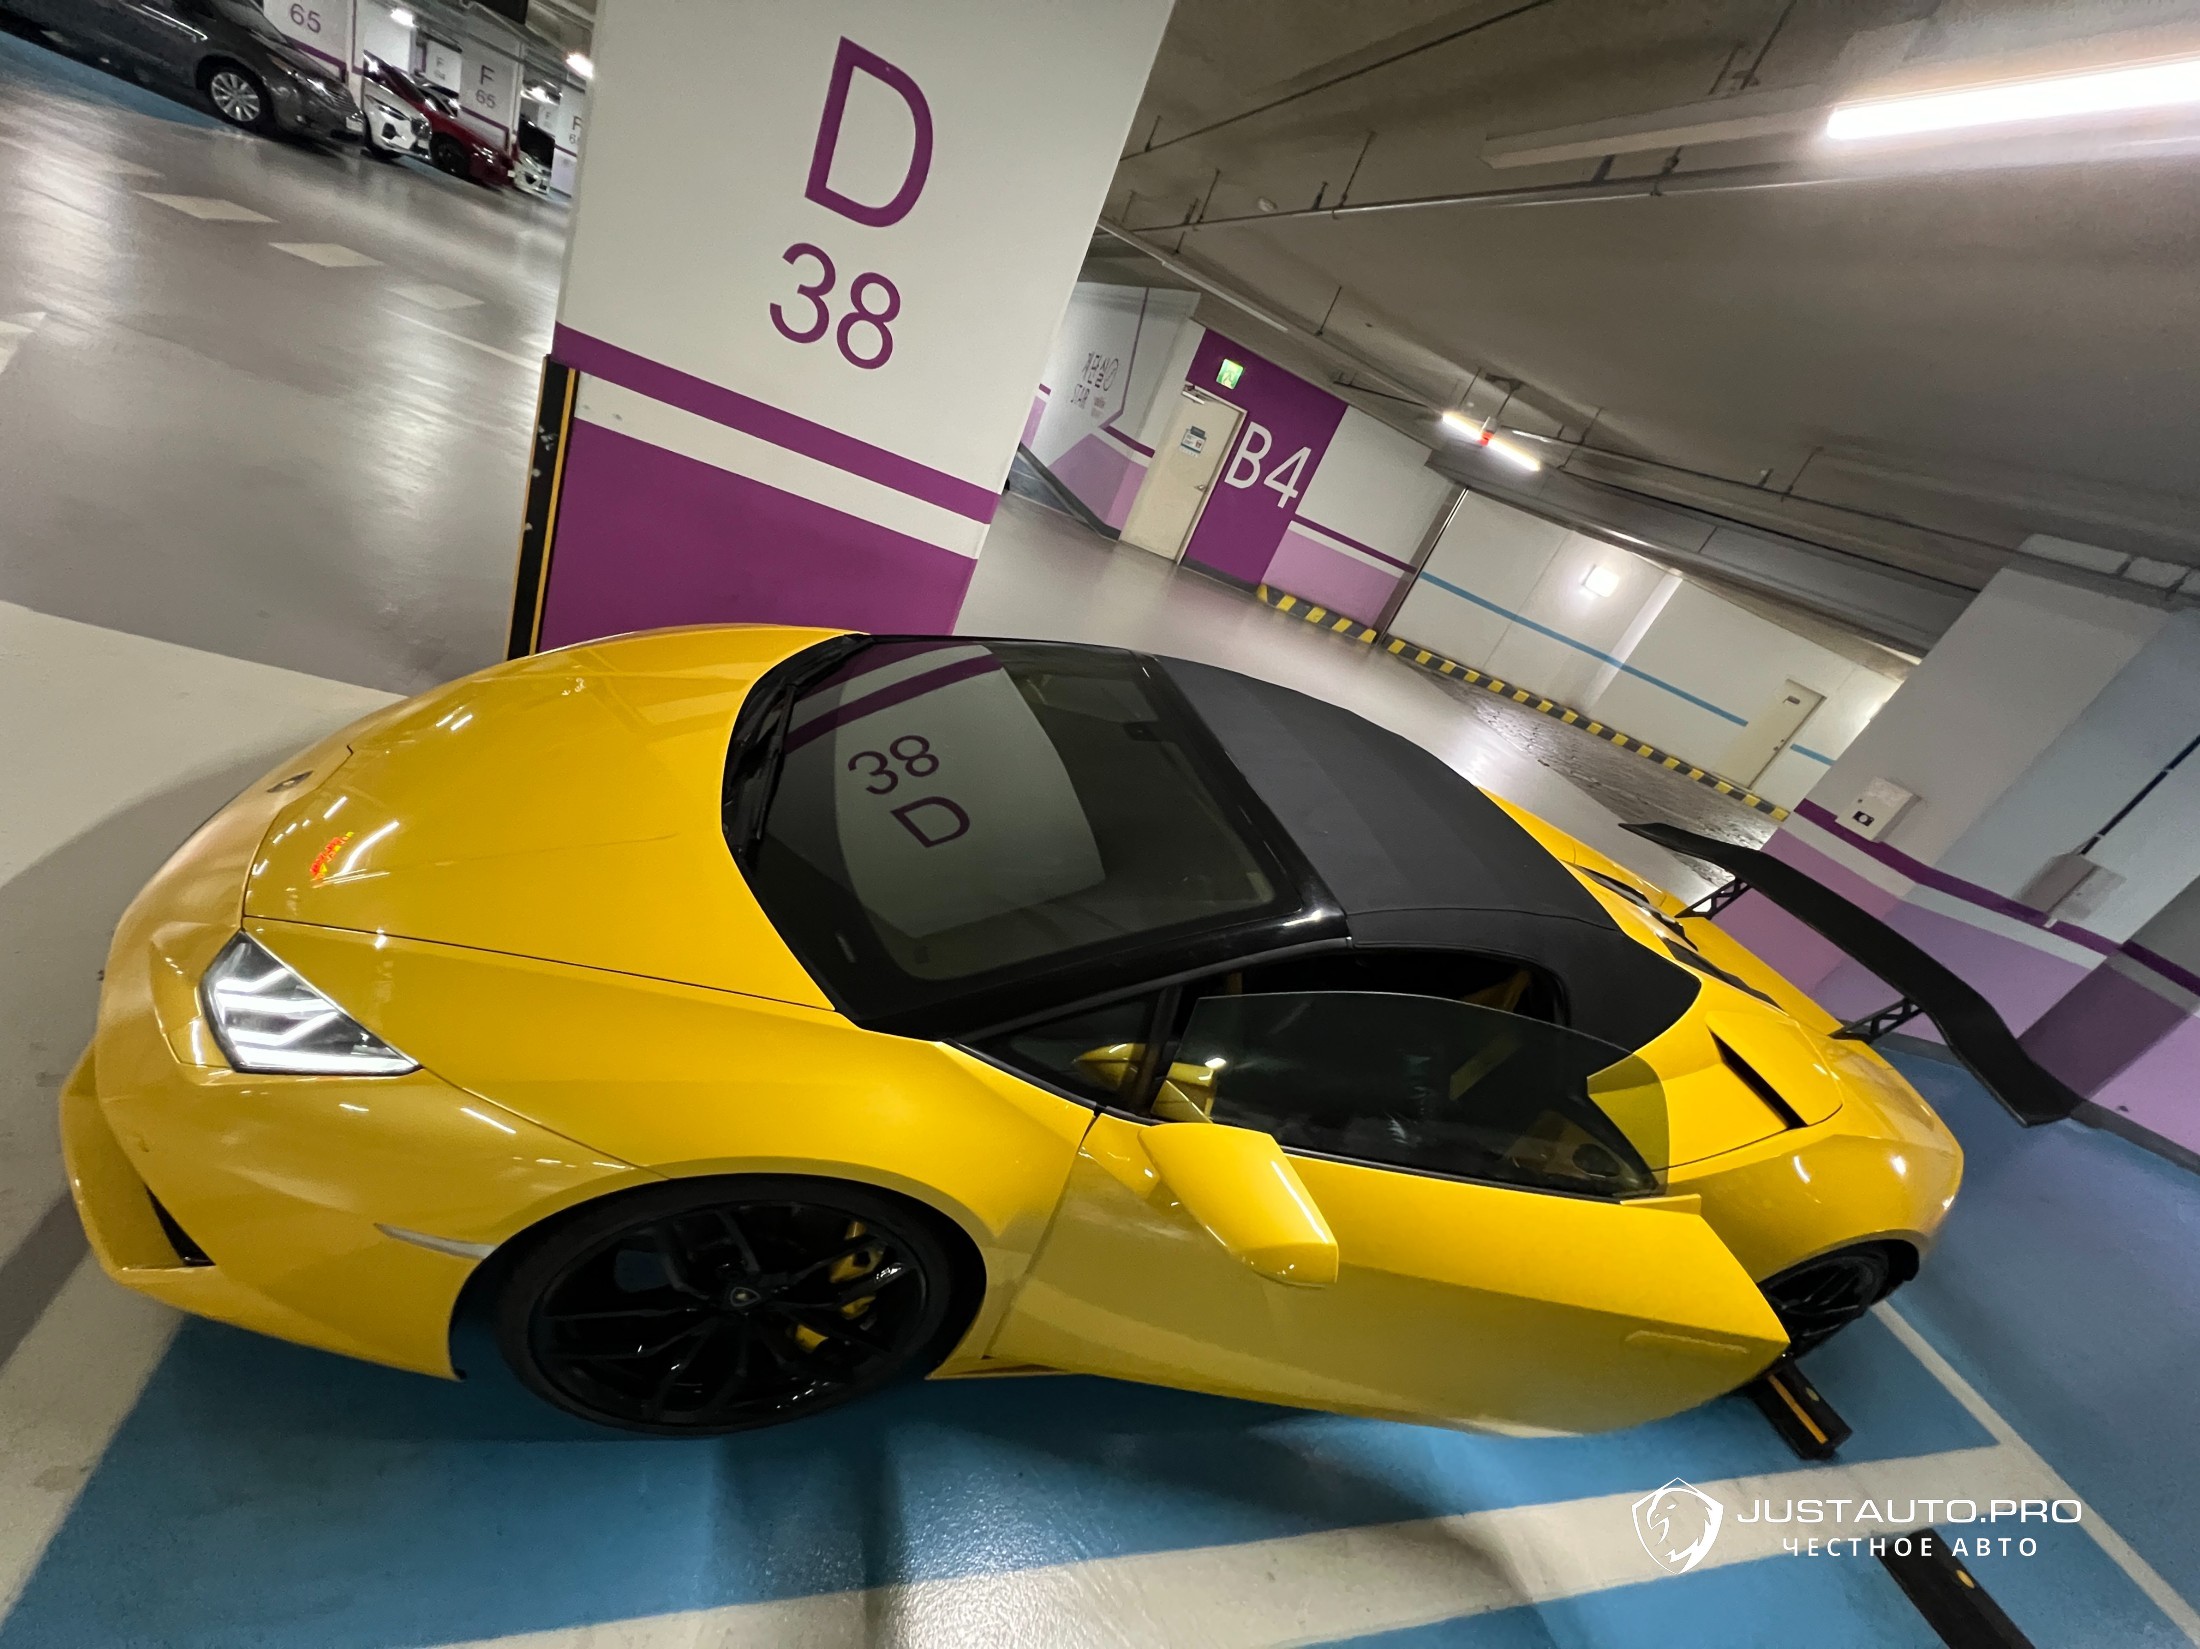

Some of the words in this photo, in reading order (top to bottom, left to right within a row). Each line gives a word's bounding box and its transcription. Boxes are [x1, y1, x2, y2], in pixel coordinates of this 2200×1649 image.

[290, 3, 321, 34] 65
[480, 64, 495, 85] F
[476, 89, 496, 109] 65
[572, 115, 583, 130] F
[804, 35, 934, 228] D
[770, 242, 901, 370] 38
[1223, 421, 1312, 509] B4
